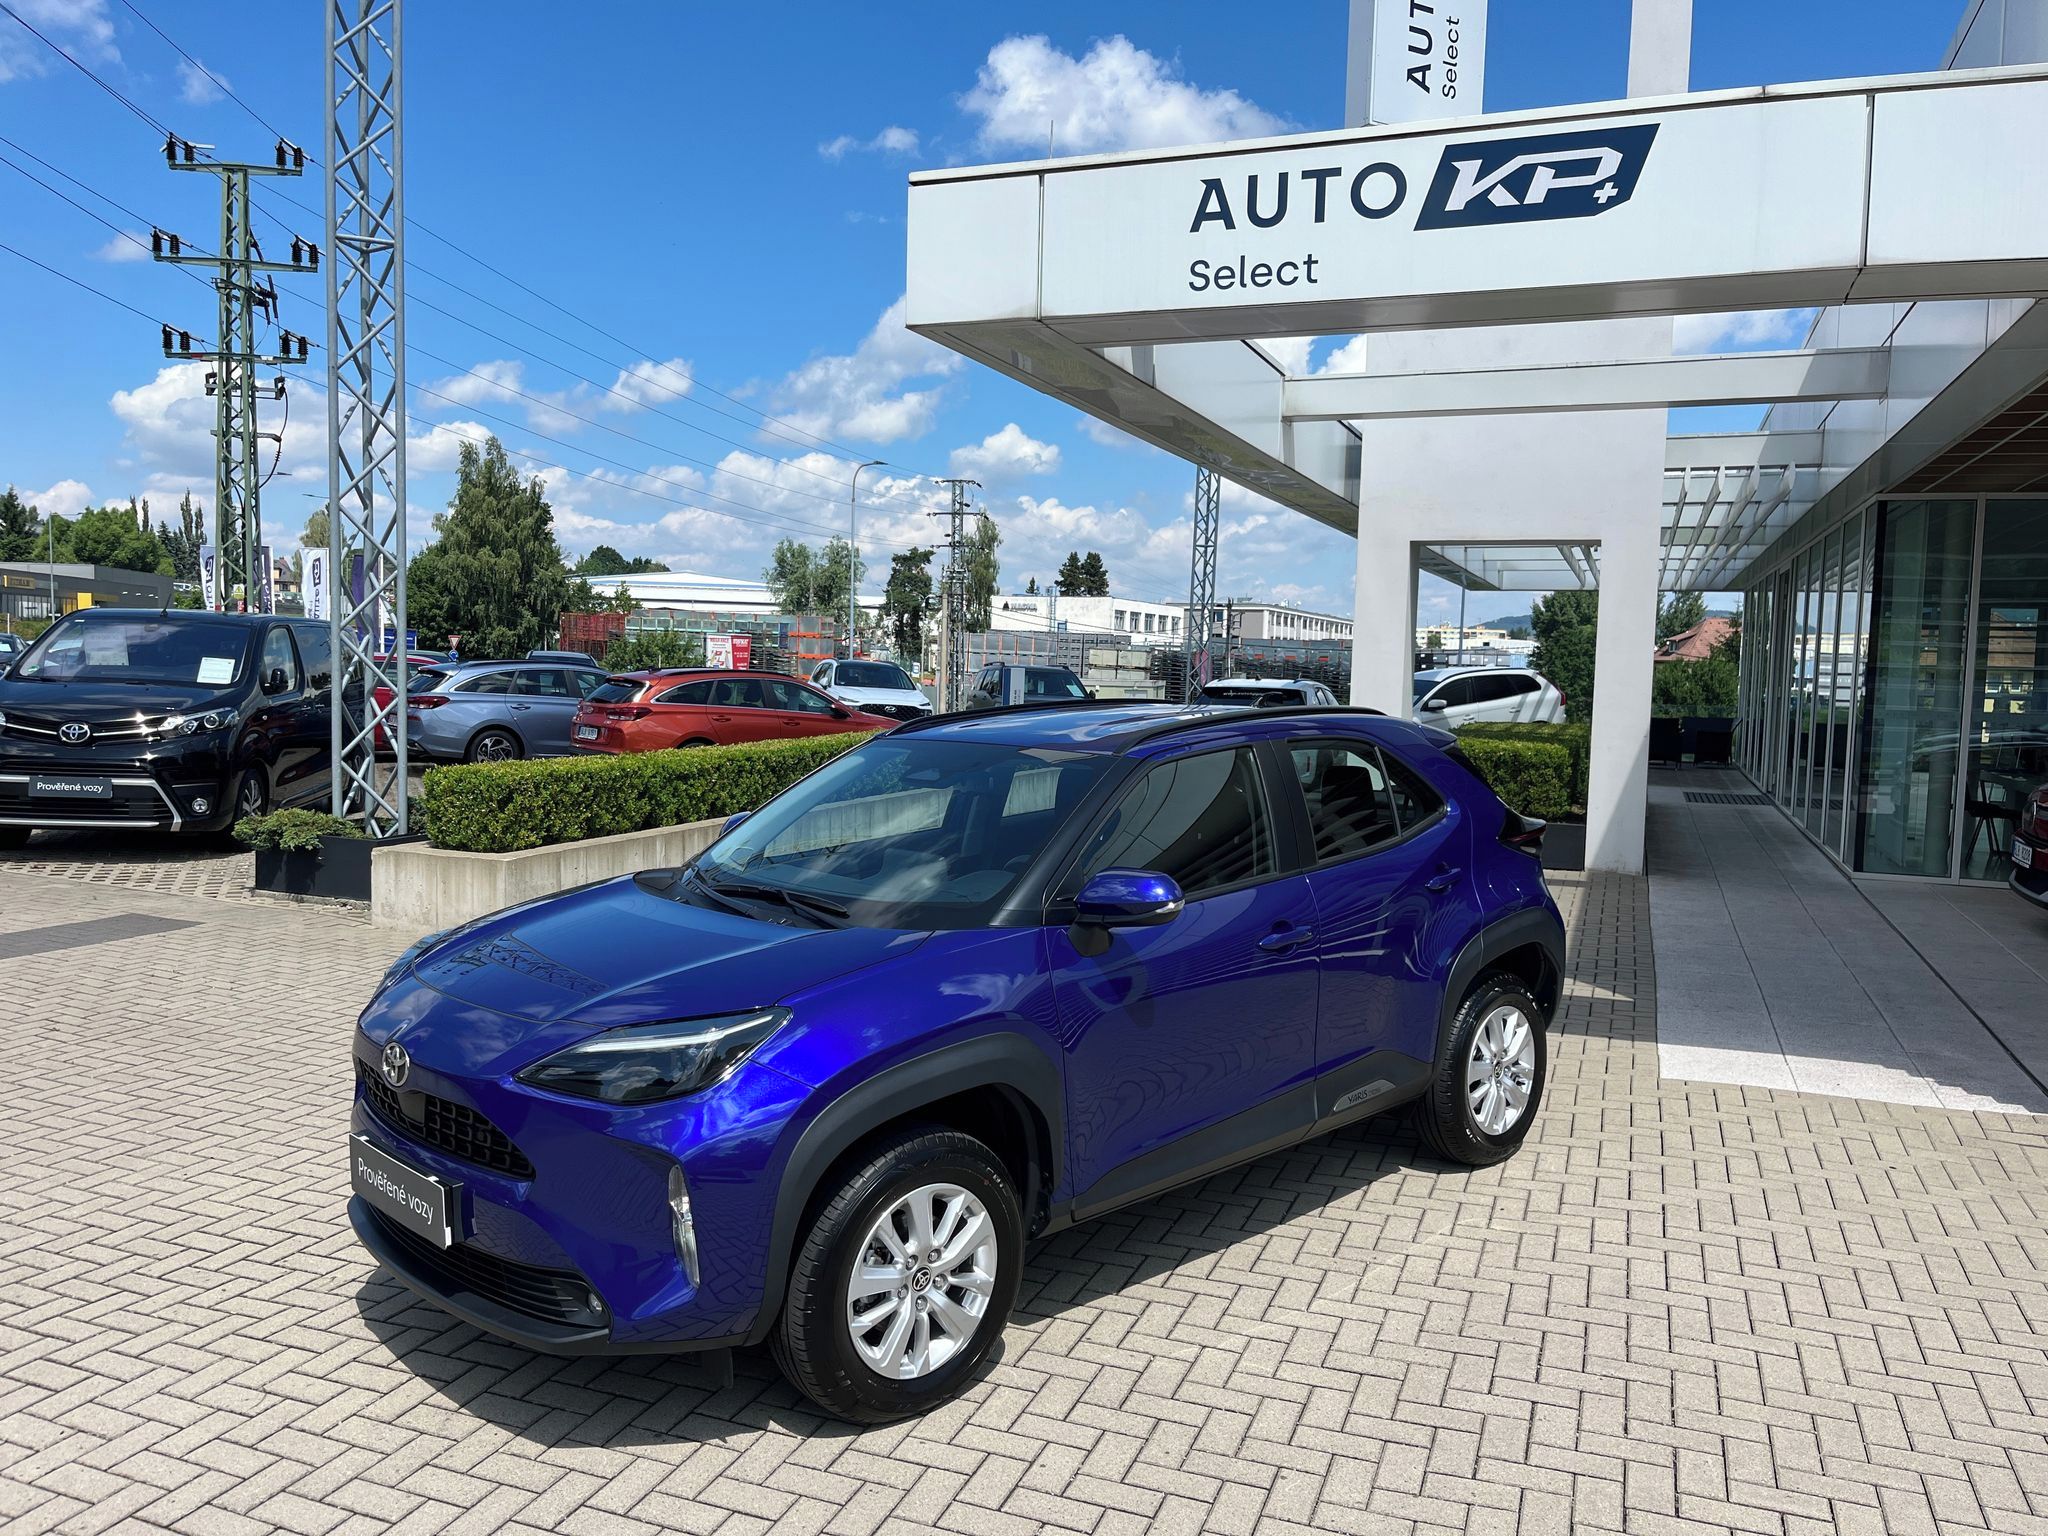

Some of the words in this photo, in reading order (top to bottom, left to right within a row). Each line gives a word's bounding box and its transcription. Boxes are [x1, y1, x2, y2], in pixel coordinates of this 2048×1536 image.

[1442, 16, 1460, 100] Select
[1190, 161, 1408, 233] AUTO
[1188, 253, 1319, 293] Select
[36, 781, 82, 791] Prověřené
[82, 785, 104, 794] vozy
[357, 1156, 406, 1205] Prověřené
[407, 1193, 434, 1225] vozy
